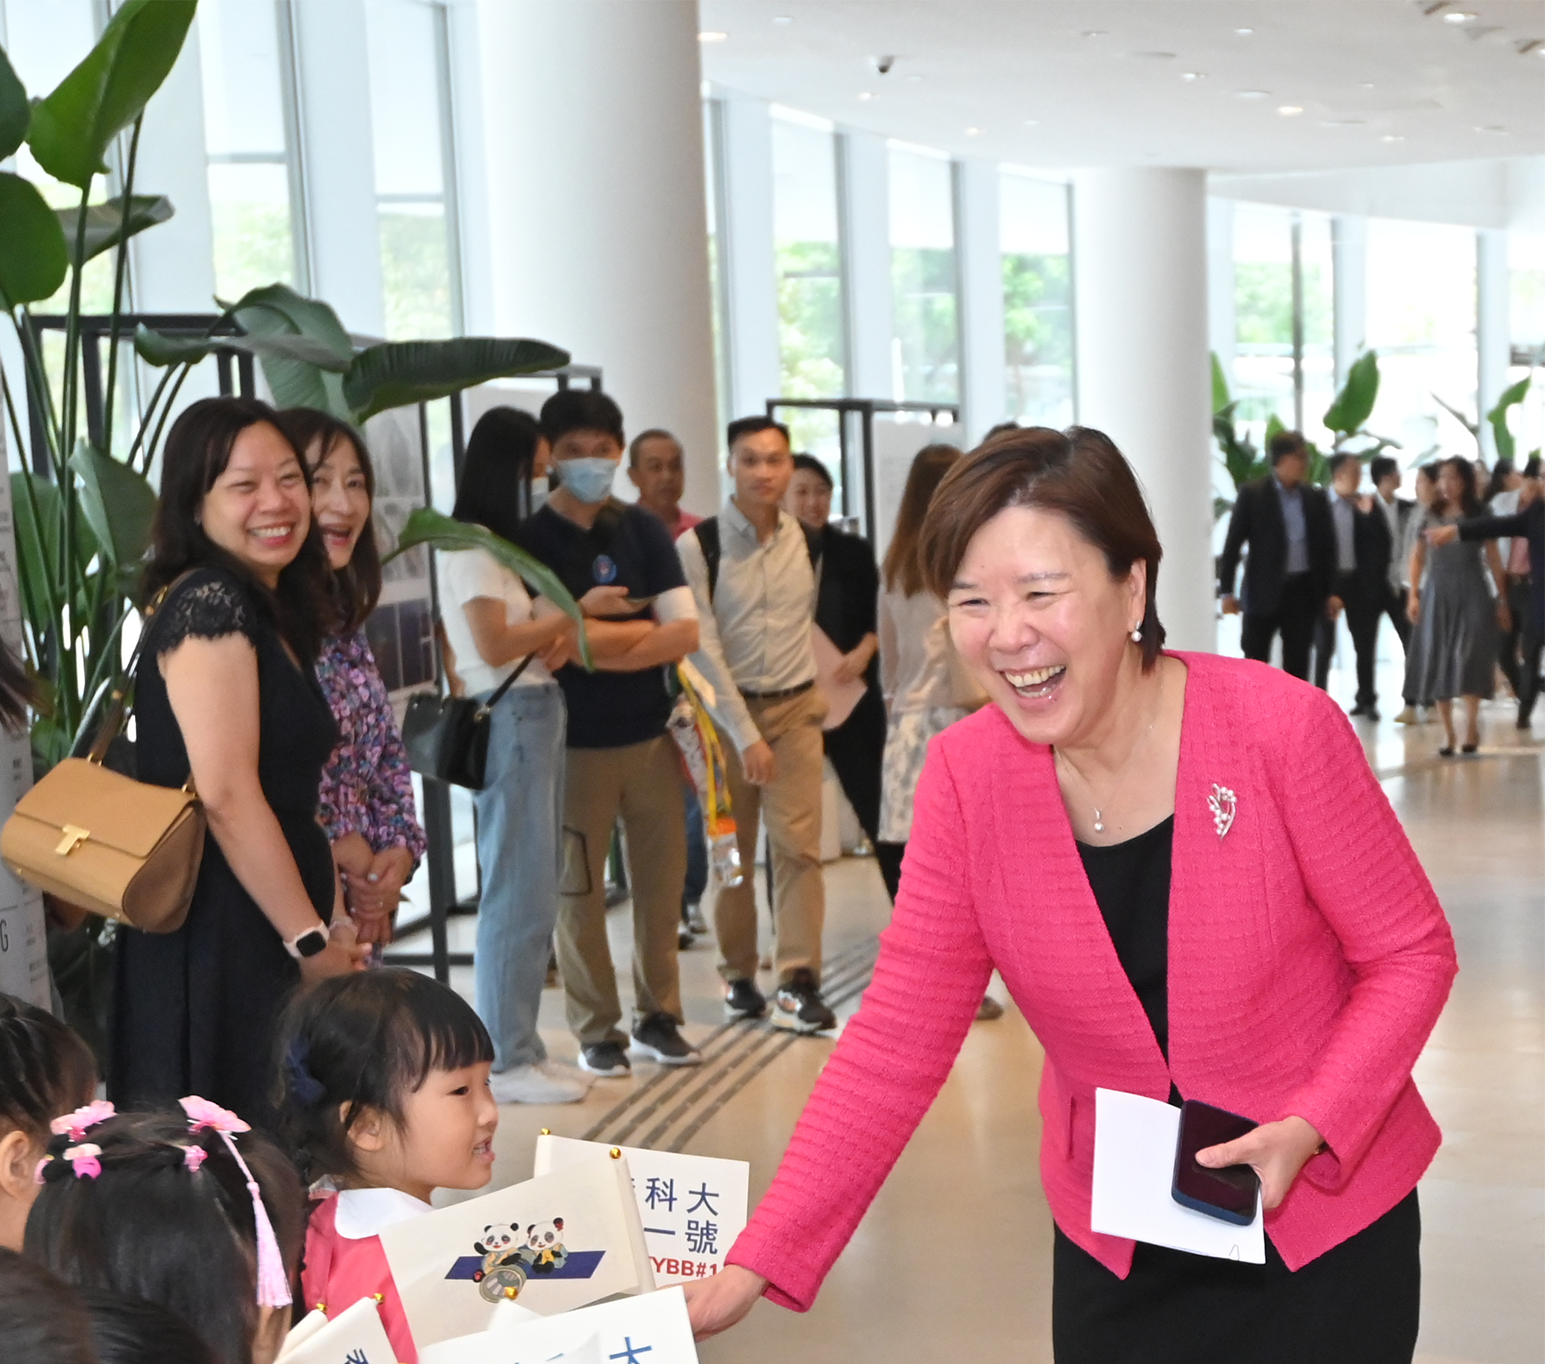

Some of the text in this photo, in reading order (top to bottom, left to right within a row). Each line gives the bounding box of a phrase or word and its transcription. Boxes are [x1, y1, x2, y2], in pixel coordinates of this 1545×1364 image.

[0, 919, 9, 952] G
[631, 1177, 719, 1217] 科大
[643, 1219, 719, 1255] 一號
[648, 1256, 718, 1277] YBB#1
